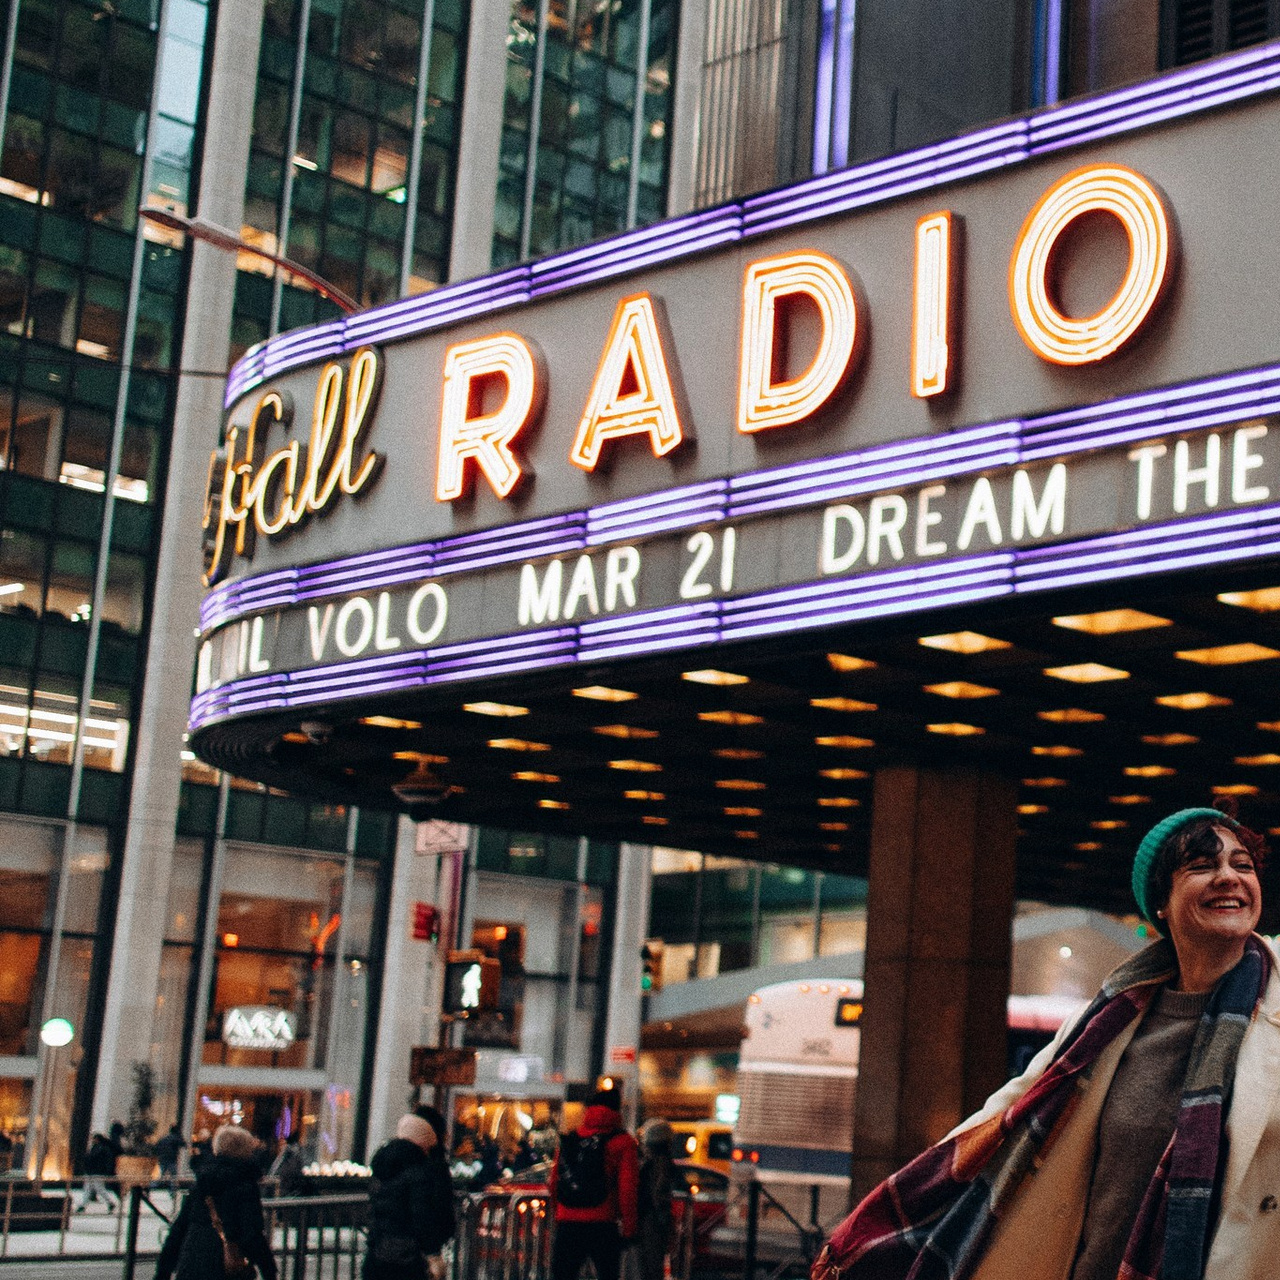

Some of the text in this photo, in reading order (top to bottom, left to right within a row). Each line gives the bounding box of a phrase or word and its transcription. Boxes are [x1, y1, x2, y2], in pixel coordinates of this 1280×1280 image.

[436, 162, 1170, 503] RADIO
[308, 582, 449, 661] VOLO
[518, 545, 641, 626] MAR
[680, 526, 737, 599] 21
[820, 463, 1068, 576] DREAM
